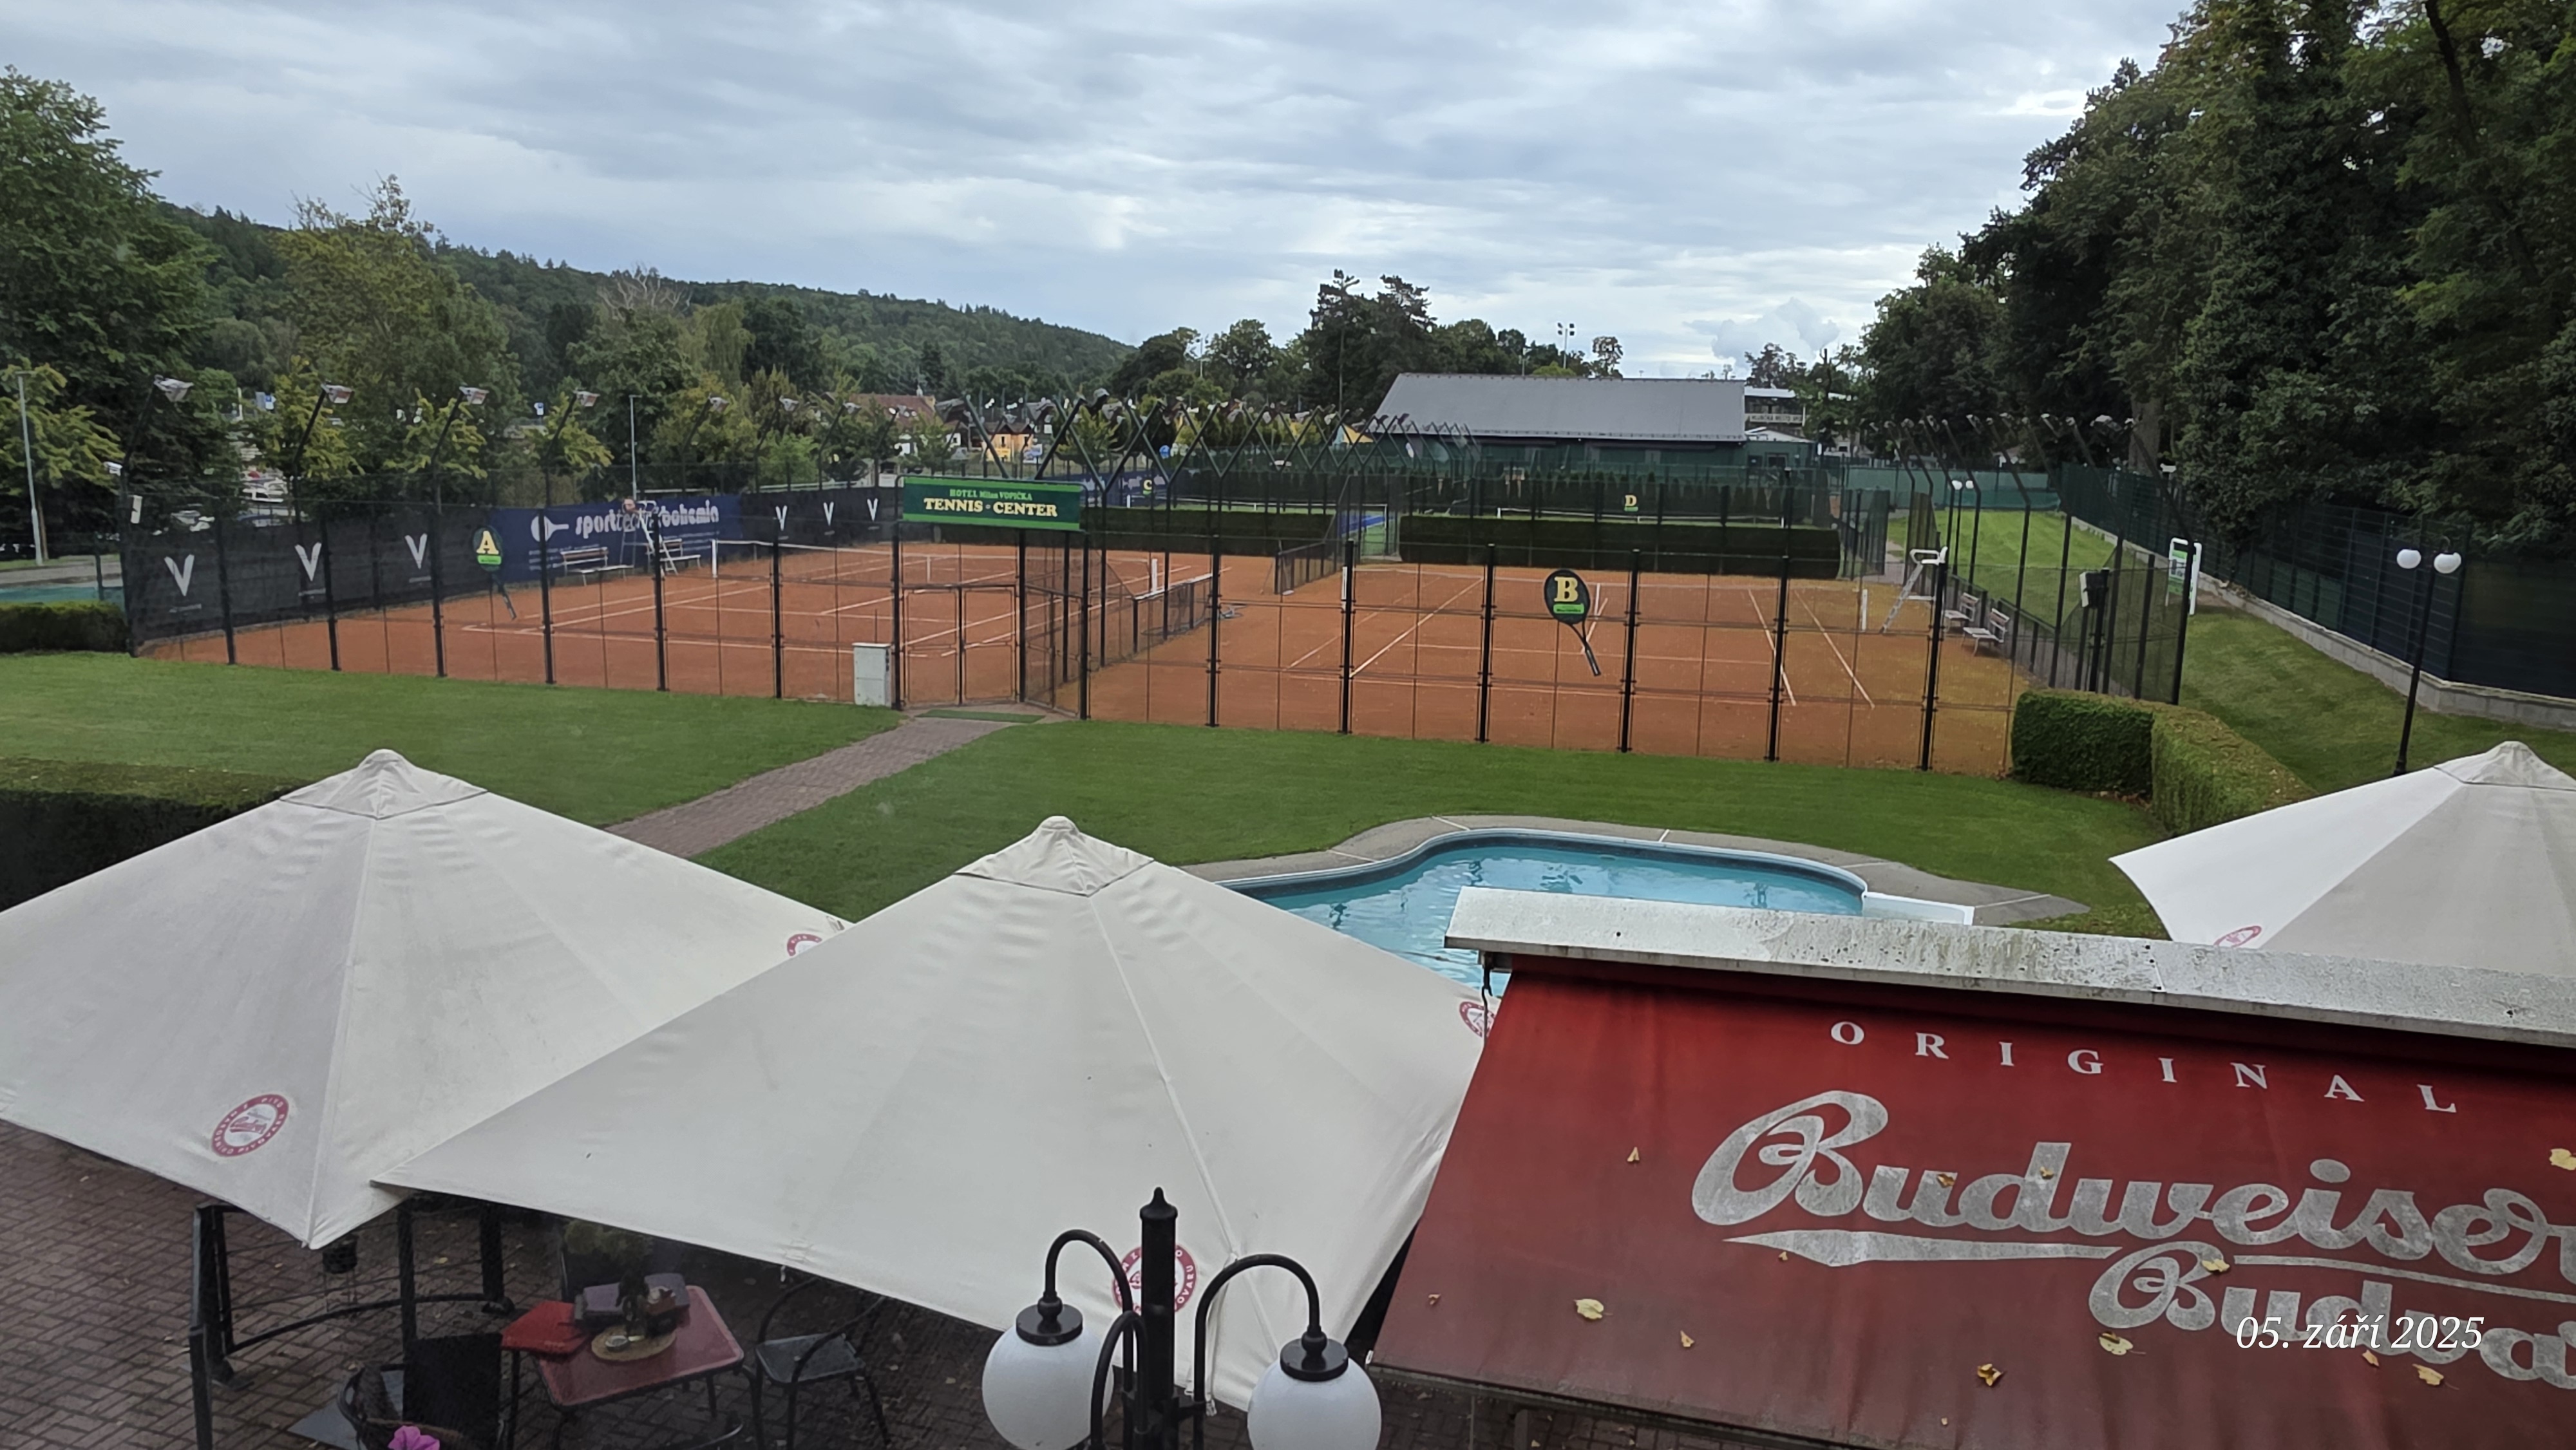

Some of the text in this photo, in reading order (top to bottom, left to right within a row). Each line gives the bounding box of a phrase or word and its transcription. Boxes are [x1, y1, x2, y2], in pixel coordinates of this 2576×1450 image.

[949, 489, 978, 498] HOTEL
[1625, 494, 1637, 507] D
[923, 498, 1058, 517] TENNIS CENTER
[476, 530, 499, 555] A
[1553, 576, 1578, 602] B
[1831, 1021, 2457, 1113] ORIGINAL
[2088, 1241, 2576, 1389] Budva
